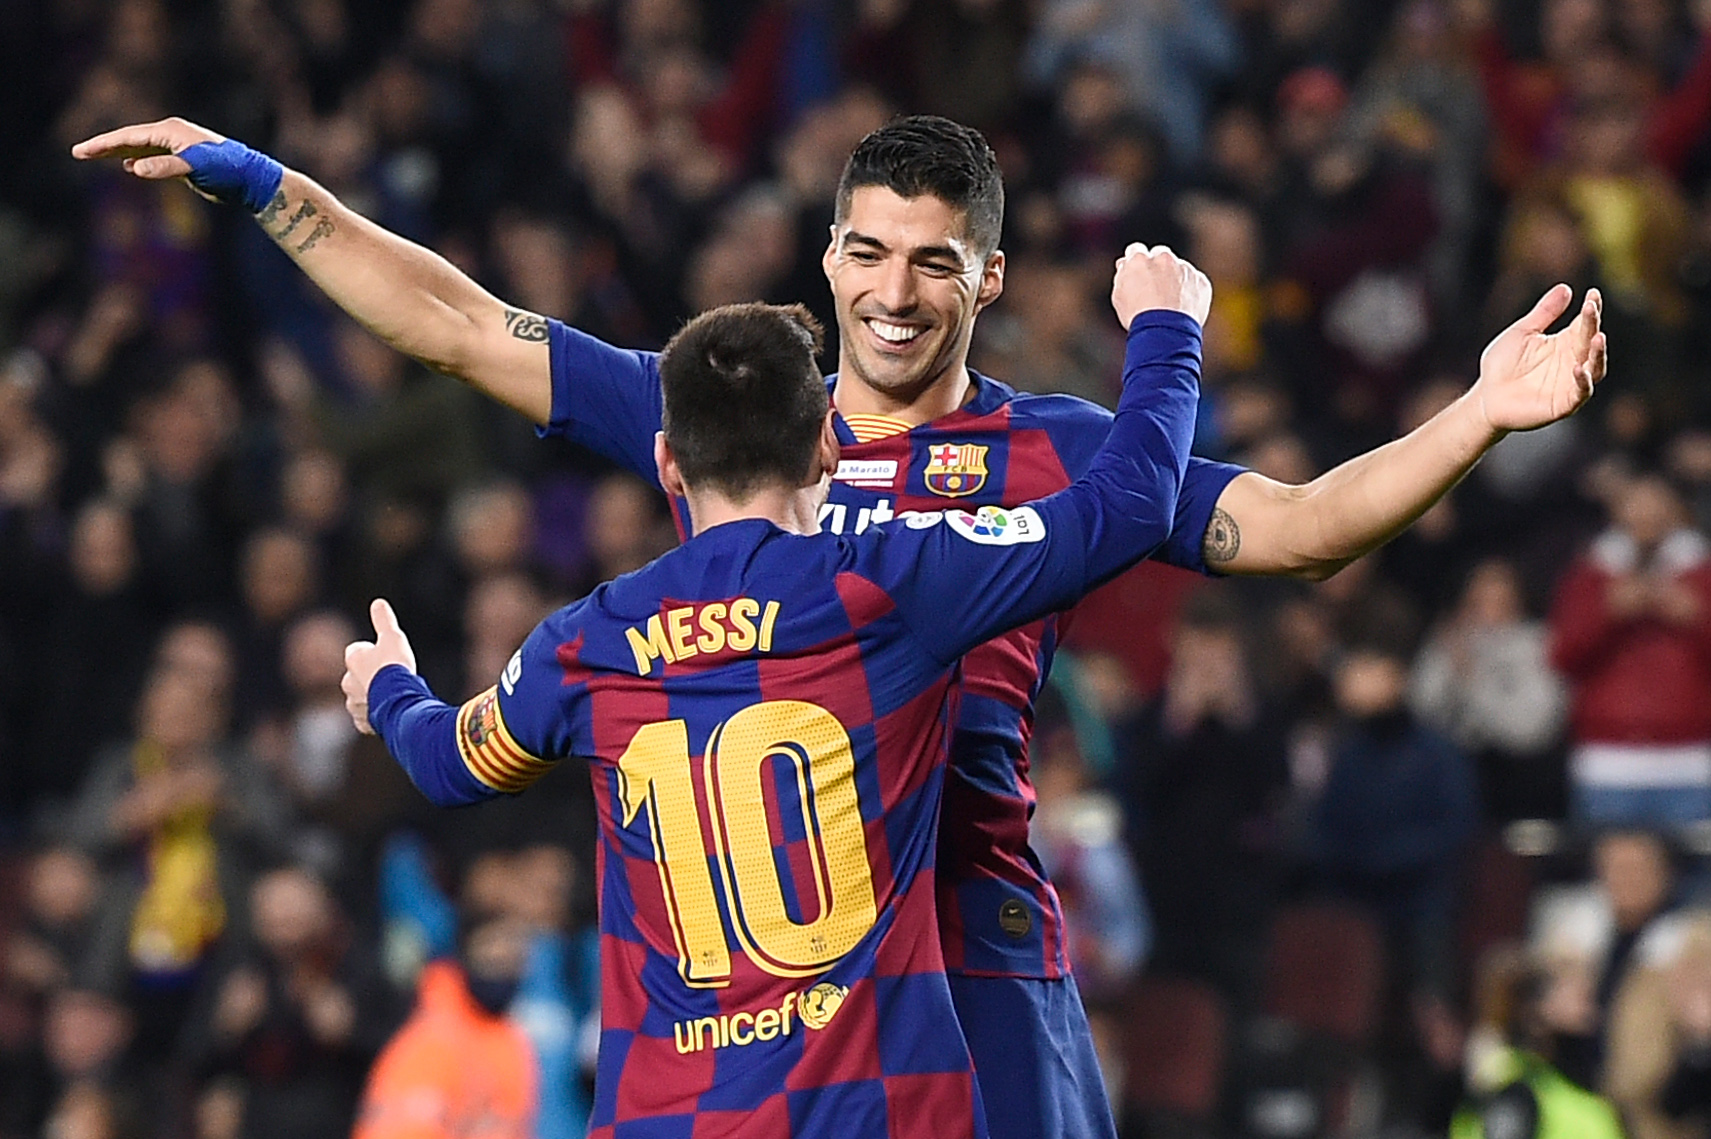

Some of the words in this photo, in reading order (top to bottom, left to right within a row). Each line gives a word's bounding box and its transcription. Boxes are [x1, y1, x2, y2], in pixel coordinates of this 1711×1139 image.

[624, 597, 781, 676] MESSI
[615, 699, 878, 989] 10
[673, 991, 798, 1054] unicef
